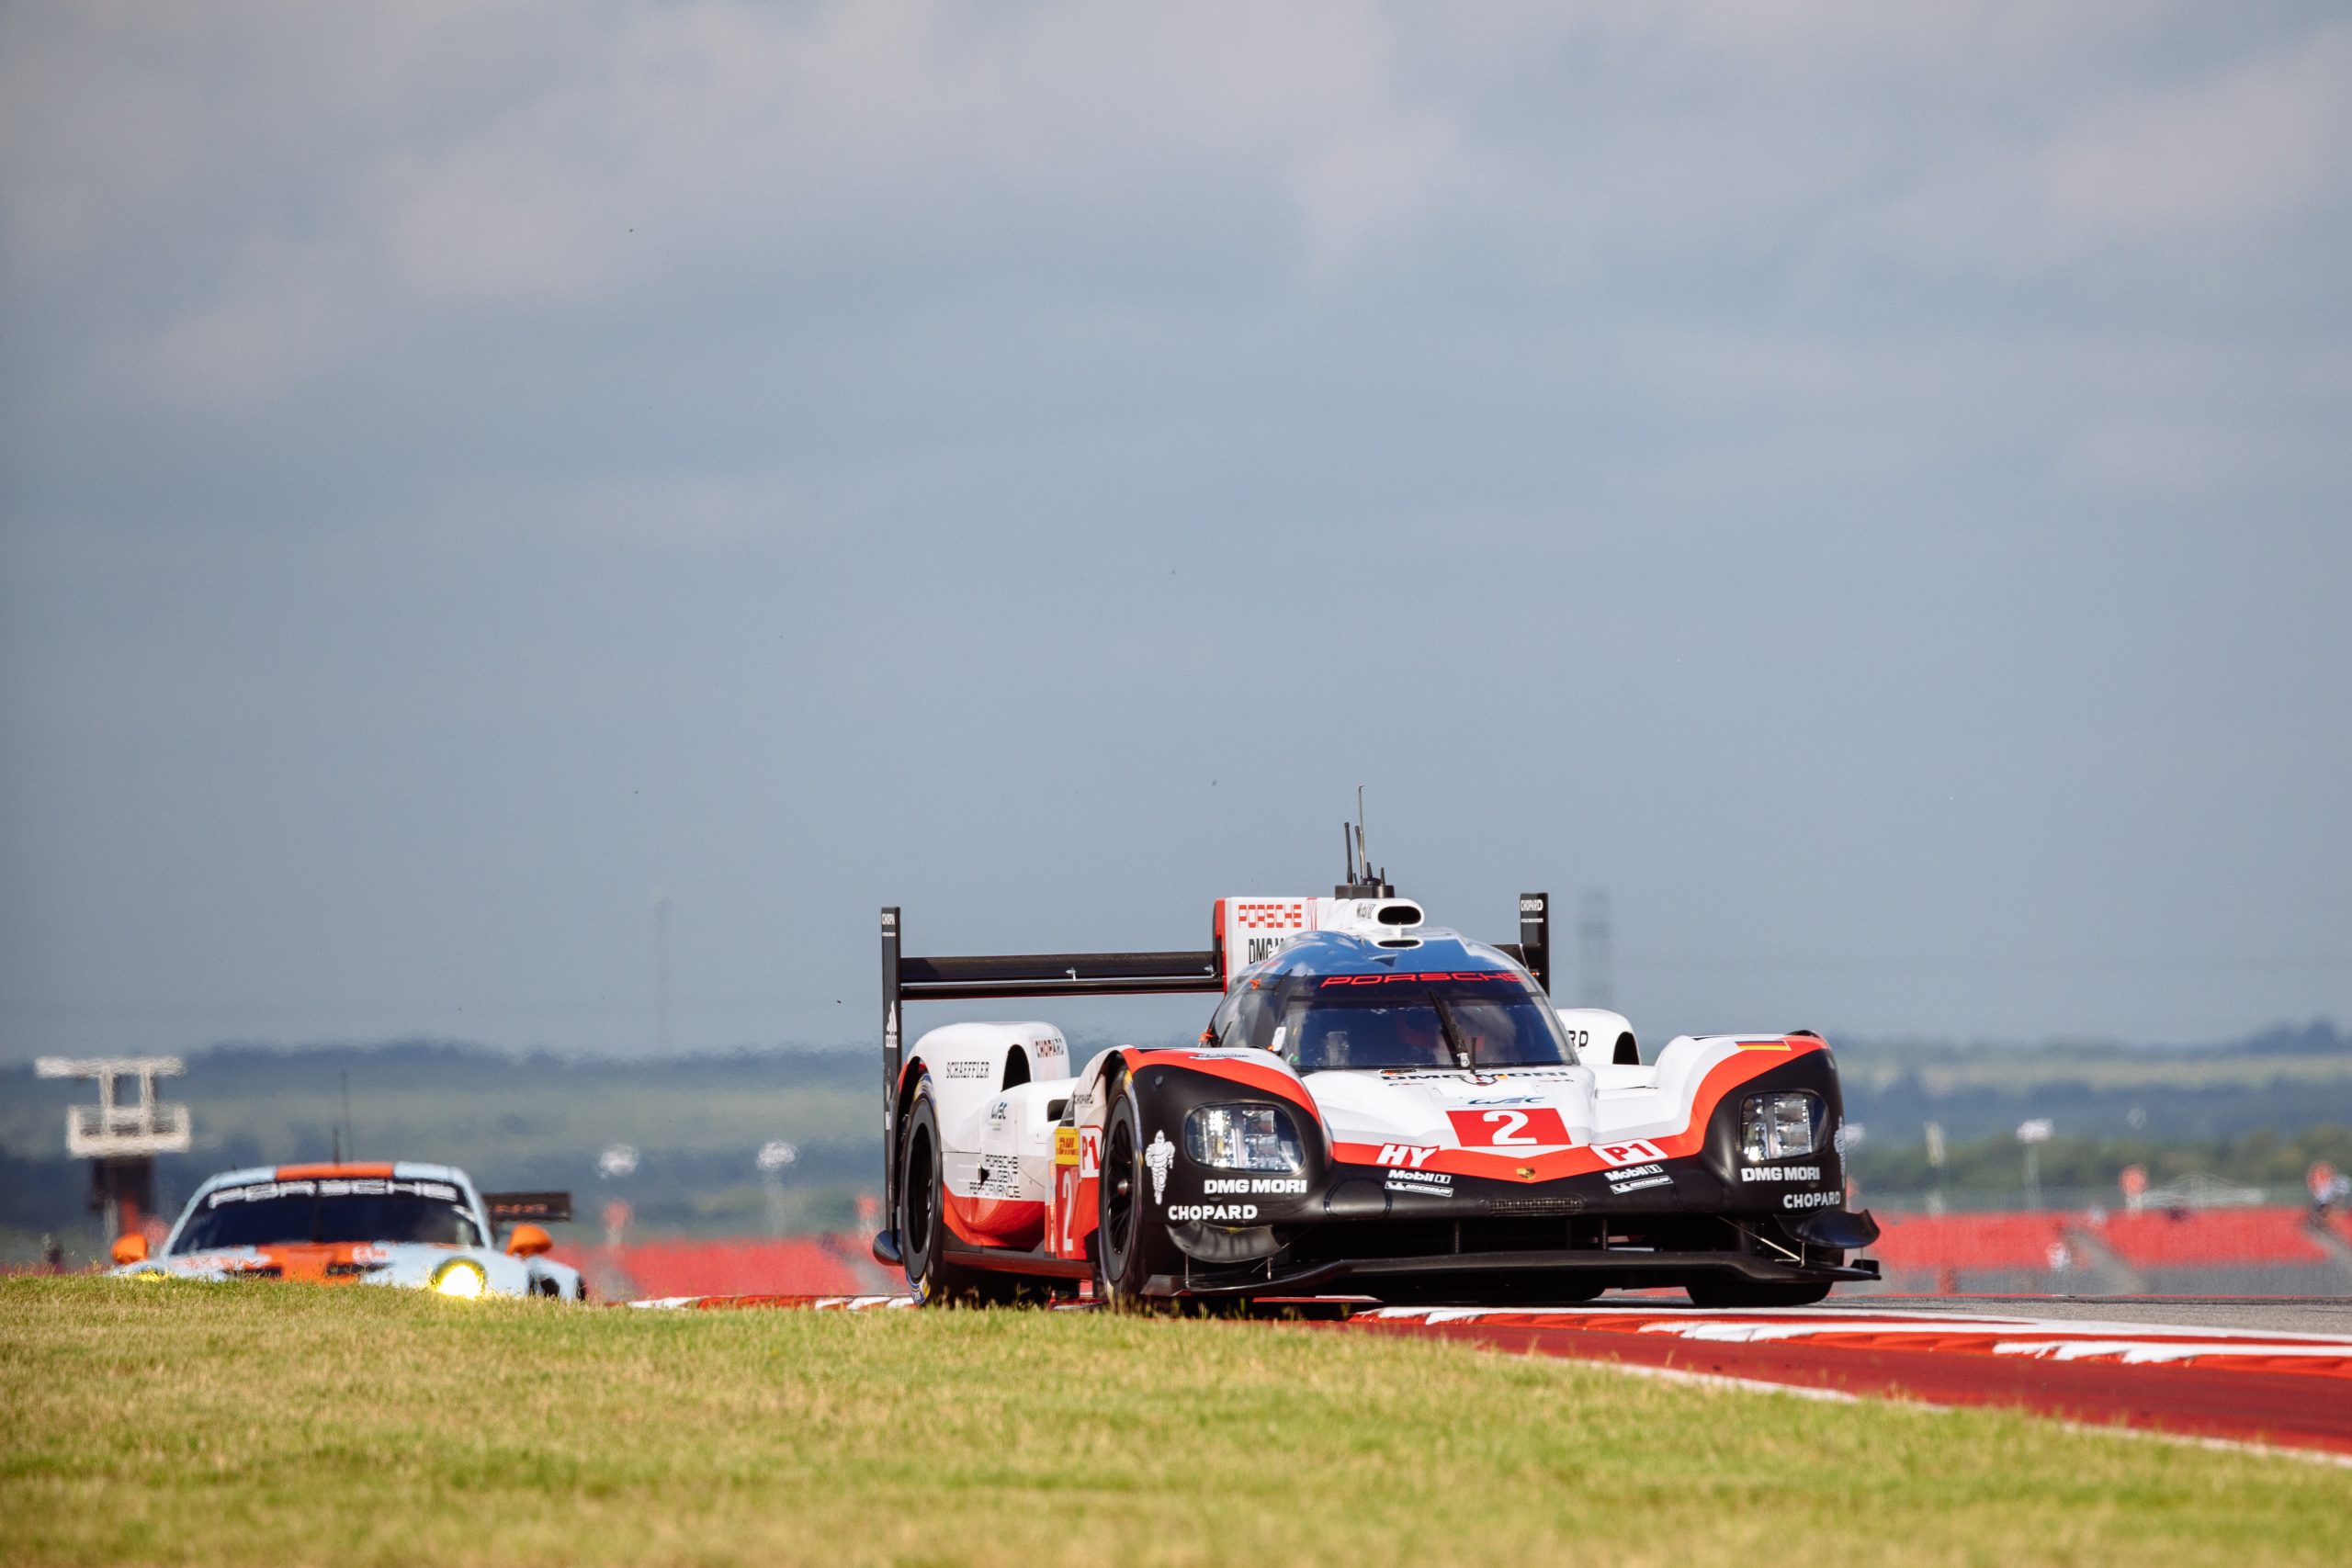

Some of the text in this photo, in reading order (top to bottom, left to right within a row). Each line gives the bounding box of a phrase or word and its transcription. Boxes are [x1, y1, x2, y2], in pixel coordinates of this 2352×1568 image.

[1238, 904, 1302, 928] PORSCHE
[1320, 972, 1528, 988] PORSCHE
[946, 1061, 990, 1078] SCHAEFFLER
[1482, 1110, 1537, 1145] 2
[1081, 1135, 1100, 1170] P1
[1376, 1144, 1438, 1168] HY
[1602, 1144, 1655, 1161] P1
[986, 1154, 1019, 1169] PORSCHE
[1387, 1168, 1434, 1182] Mobil
[1604, 1166, 1649, 1181] Mobil
[1740, 1167, 1821, 1182] DMG MORI
[209, 1179, 458, 1209] PORSCHE
[1204, 1179, 1307, 1194] DMG MORI
[1783, 1190, 1840, 1209] CHOPARD
[1062, 1170, 1073, 1251] 2
[1168, 1204, 1258, 1221] CHOPARD
